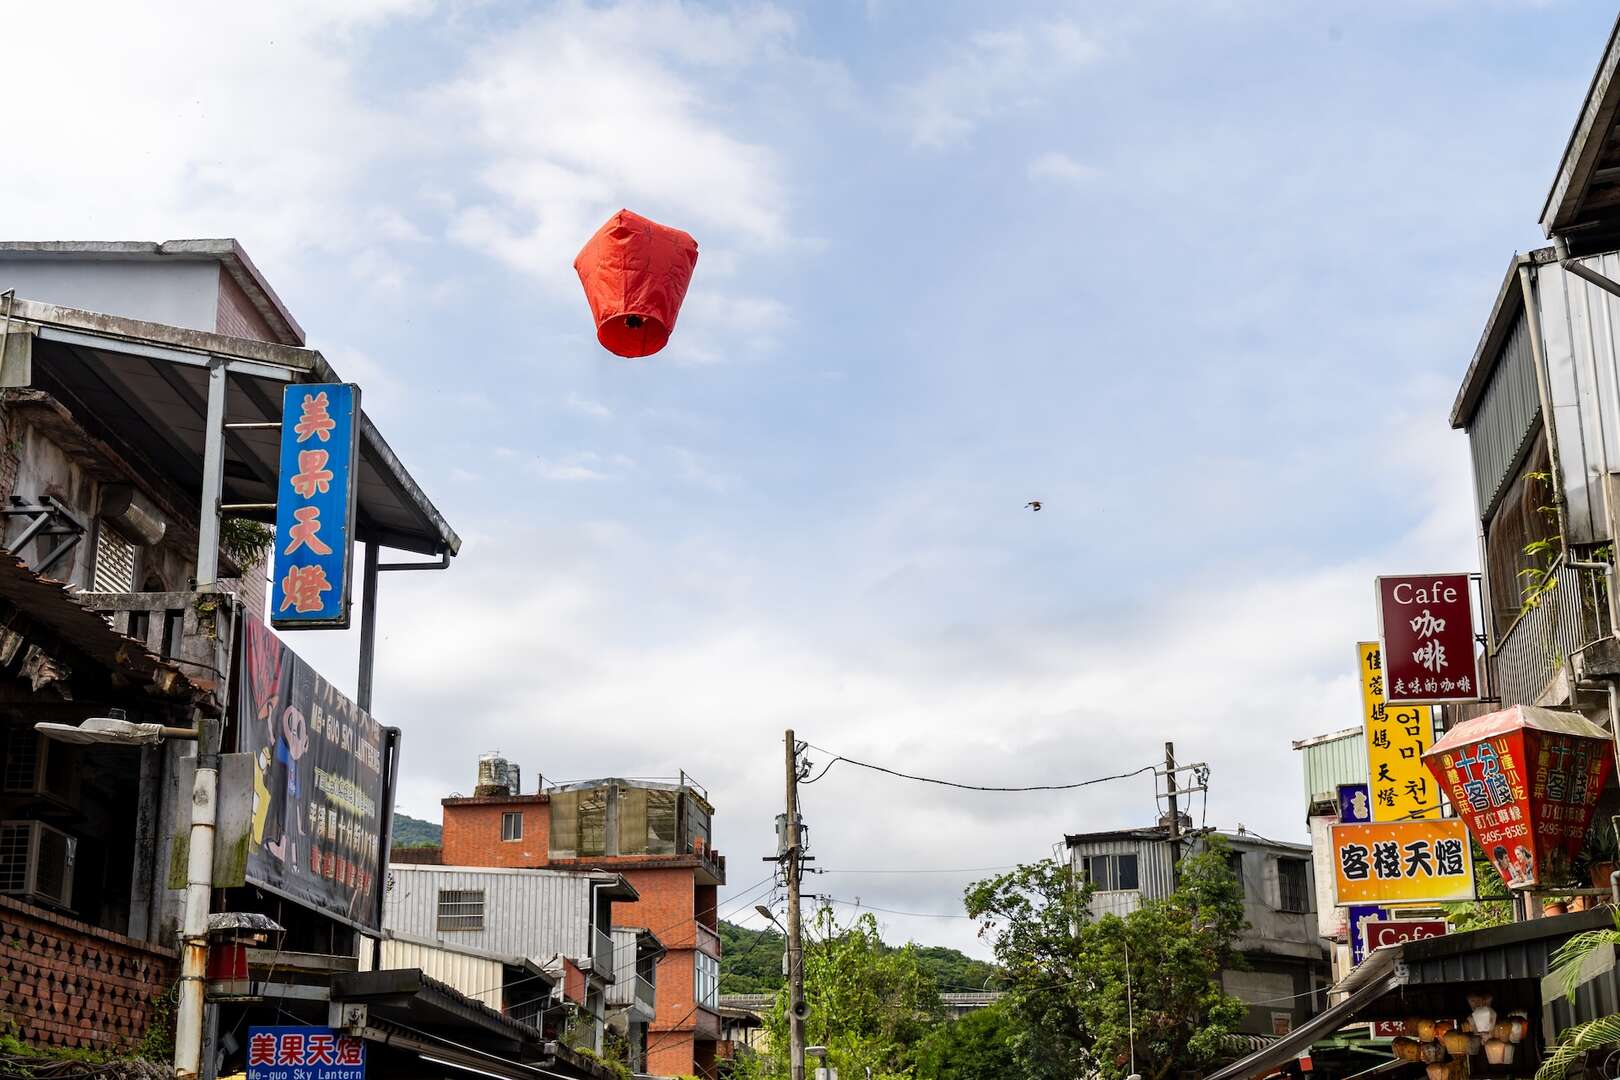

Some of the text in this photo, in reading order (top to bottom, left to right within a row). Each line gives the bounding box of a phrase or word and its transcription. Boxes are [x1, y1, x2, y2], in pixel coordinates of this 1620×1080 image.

[280, 391, 336, 613] 美果天燈
[1393, 581, 1457, 604] Cafe
[1410, 609, 1448, 673] 咖啡
[1393, 676, 1471, 695] 走味的咖啡
[1456, 742, 1500, 783] 十分
[1464, 773, 1515, 812] 客棧
[1480, 824, 1528, 845] 2495-8585
[1341, 839, 1466, 880] 客棧天燈
[248, 1033, 364, 1066] 美果天燈
[293, 1068, 312, 1080] Sky
[317, 1069, 362, 1080] Lantern
